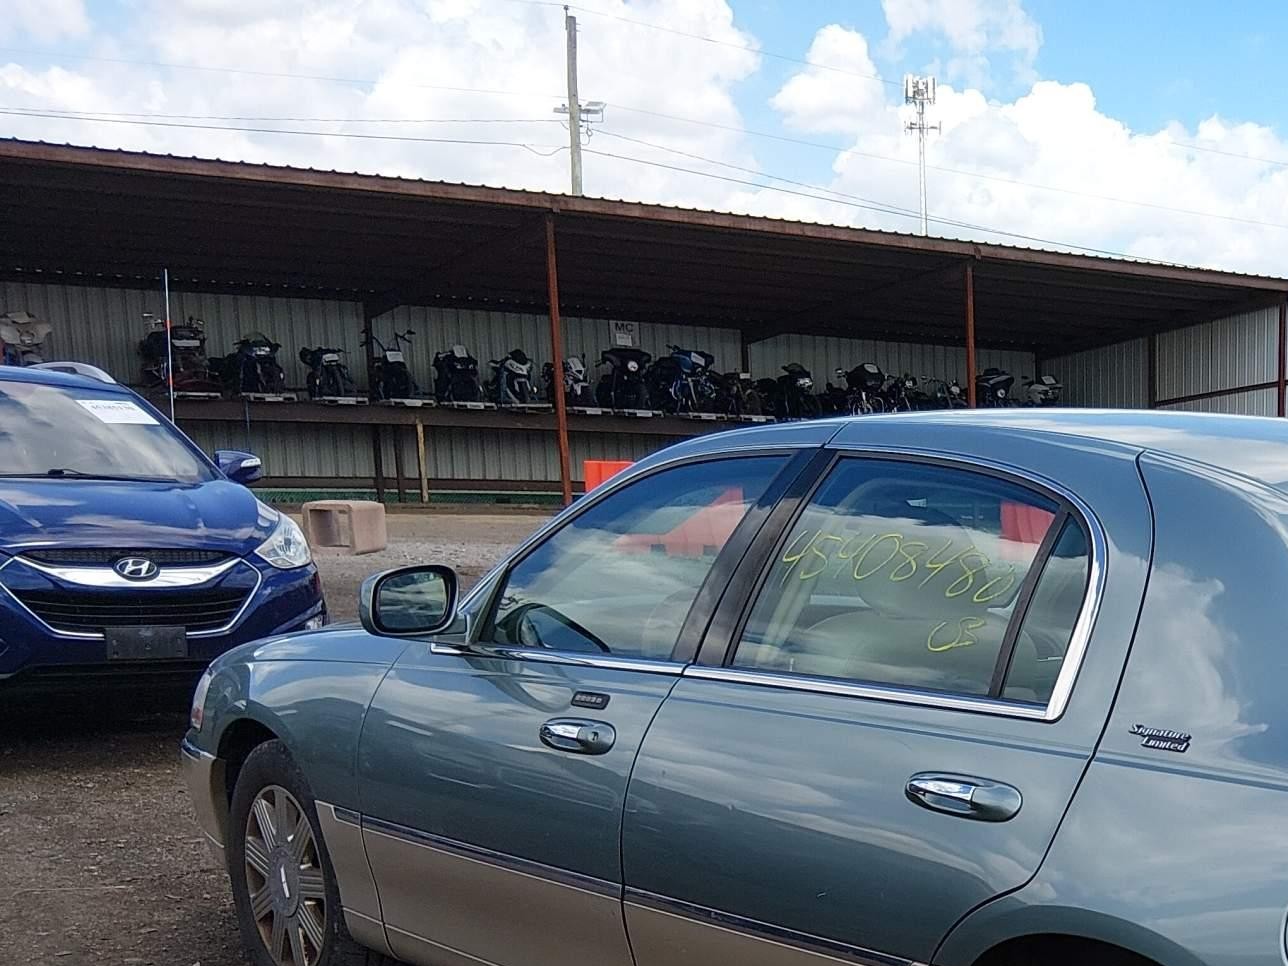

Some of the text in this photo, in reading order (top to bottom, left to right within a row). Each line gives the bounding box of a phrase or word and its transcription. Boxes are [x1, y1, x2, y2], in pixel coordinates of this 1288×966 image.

[615, 322, 634, 333] MC
[781, 529, 1016, 604] 45408480
[1130, 723, 1190, 741] Signature
[1142, 736, 1188, 752] Limited
